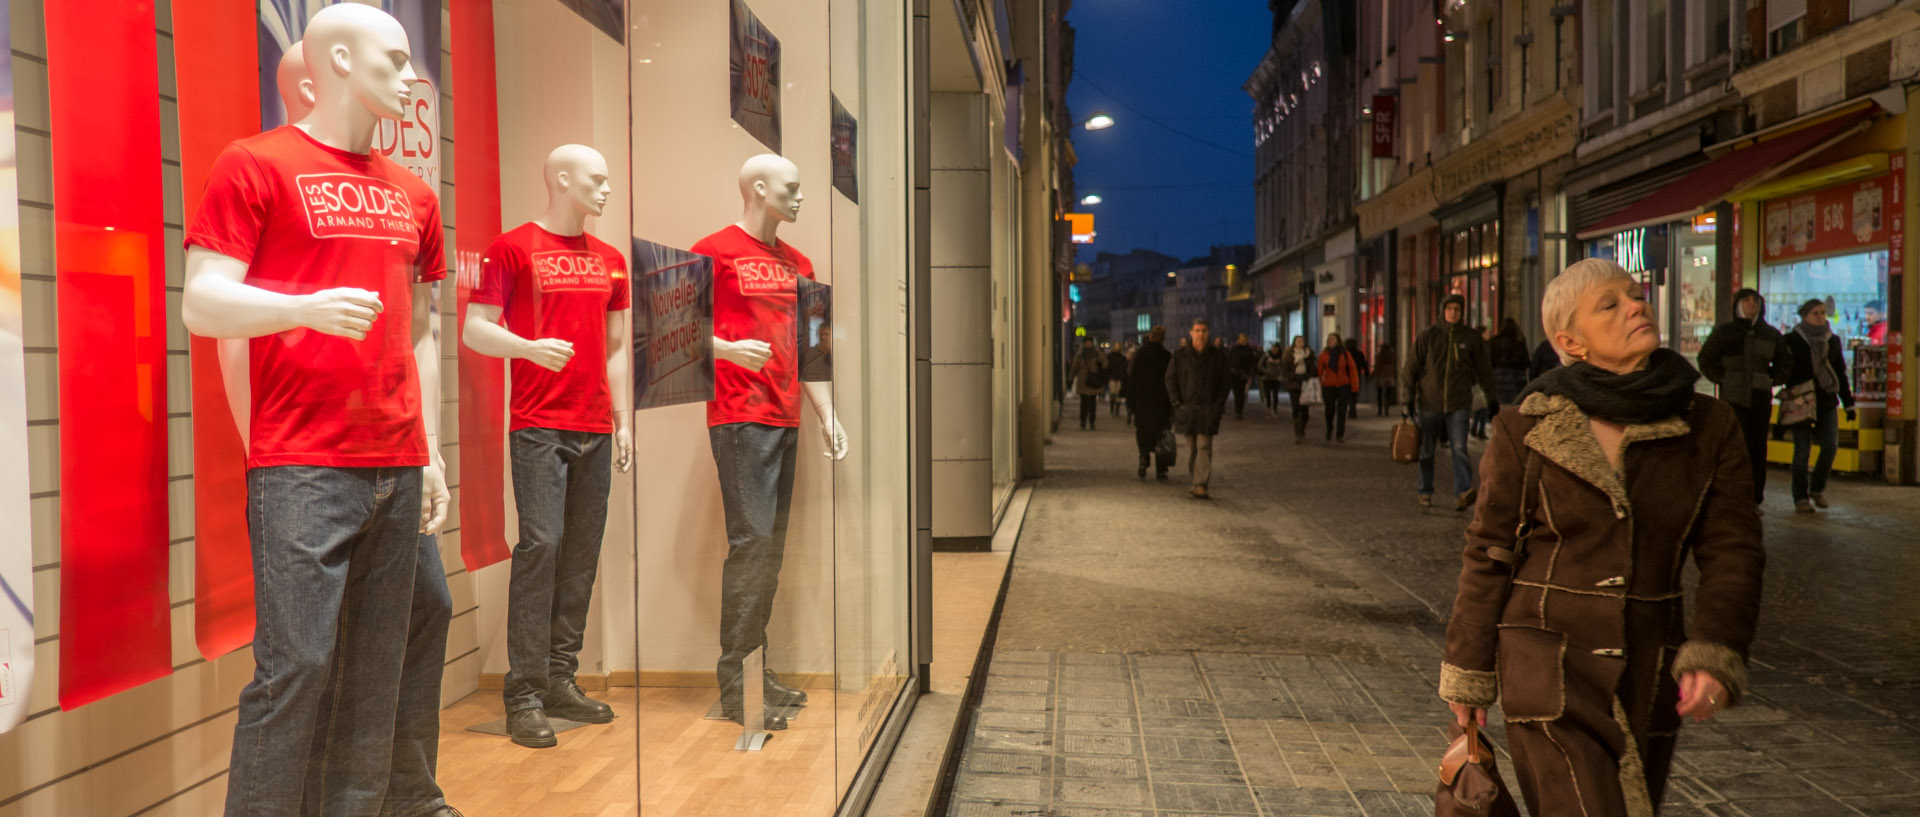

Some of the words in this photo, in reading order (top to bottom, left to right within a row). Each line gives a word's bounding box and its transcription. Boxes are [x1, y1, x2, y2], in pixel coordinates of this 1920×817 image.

[371, 98, 433, 158] DES
[1375, 111, 1391, 143] SFR
[305, 184, 329, 213] LES
[322, 182, 410, 219] SOLDES
[317, 215, 374, 229] ARMAND
[380, 219, 415, 233] THIERY
[537, 259, 551, 277] LES
[547, 256, 604, 276] SOLDES
[740, 264, 753, 281] LES
[543, 277, 580, 287] ARMAND
[744, 282, 779, 290] ARMAND
[652, 278, 698, 318] Nouvelles
